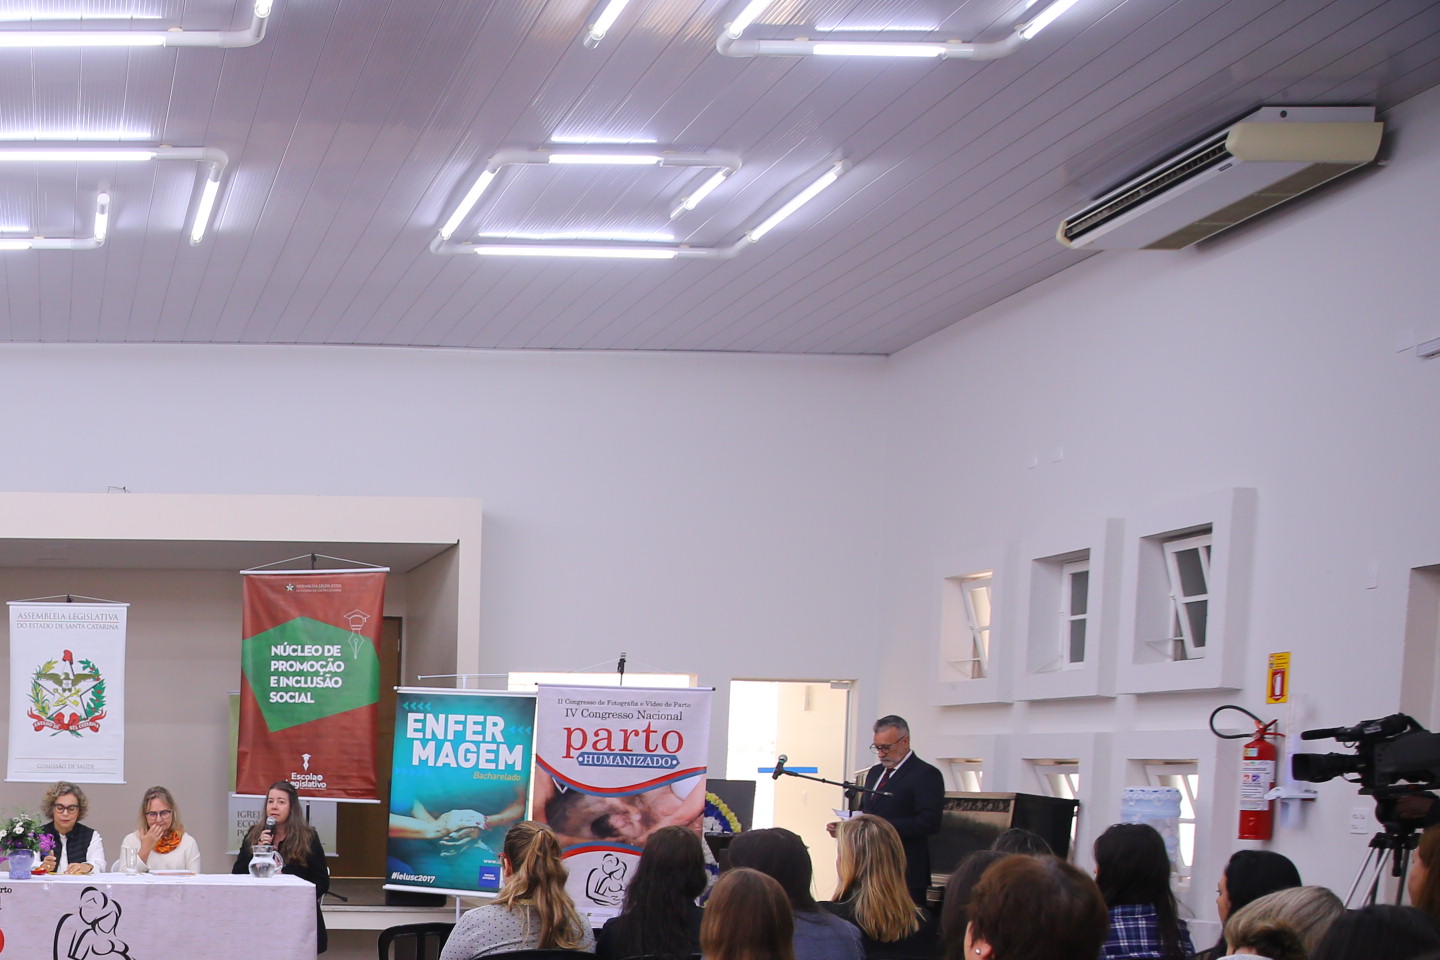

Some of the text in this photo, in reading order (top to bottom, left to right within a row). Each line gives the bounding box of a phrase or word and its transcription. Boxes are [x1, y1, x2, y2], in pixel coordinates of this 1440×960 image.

[17, 612, 119, 621] ASSEMBLEIA LEGISLATIVA
[271, 642, 341, 657] NÚCLEO DE
[270, 658, 345, 675] PROMOÇÃO
[270, 674, 342, 688] E INCLUSÃO
[269, 692, 315, 704] SOCIAL
[565, 699, 596, 707] Congresso
[565, 708, 683, 721] IV Congresso Nacional
[406, 712, 505, 742] ENFER
[562, 721, 684, 759] parto
[412, 740, 524, 771] MAGEM
[583, 754, 671, 767] HUMANIZADO
[291, 772, 317, 781] Escola
[473, 771, 521, 781] Bacharelado
[286, 779, 327, 789] egislativo
[391, 871, 436, 884] #ielusc2017
